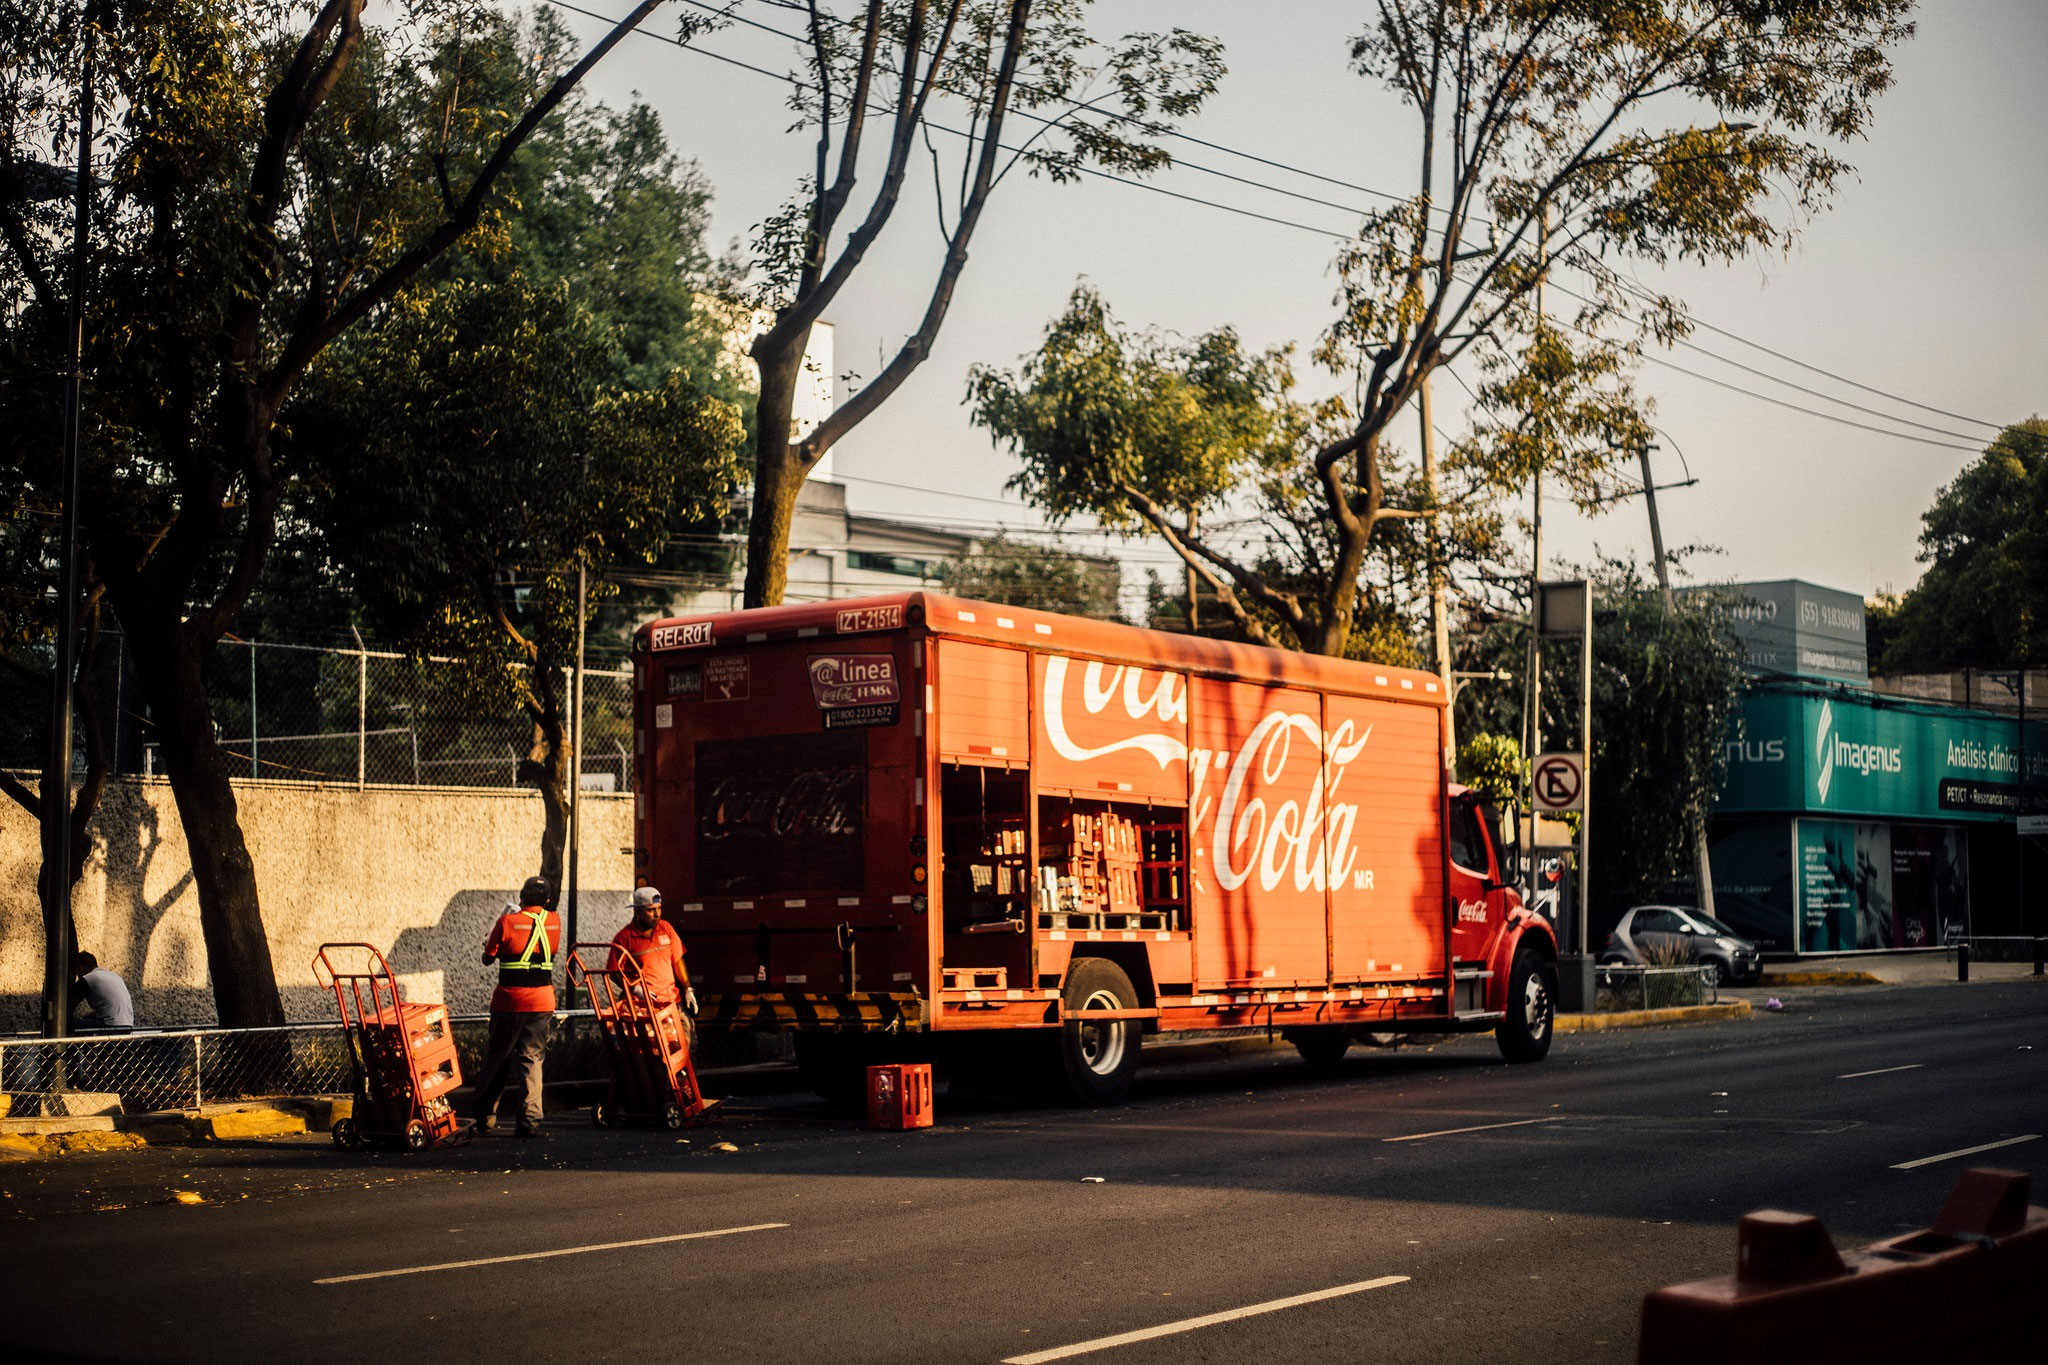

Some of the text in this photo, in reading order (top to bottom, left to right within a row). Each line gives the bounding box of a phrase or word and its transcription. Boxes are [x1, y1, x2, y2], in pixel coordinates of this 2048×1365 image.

[840, 608, 898, 630] IZT-21514
[1800, 599, 1861, 632] (55) 91830040
[653, 624, 710, 648] REI-R01
[842, 659, 891, 682] línea
[857, 685, 892, 698] FEMSA
[831, 706, 892, 720] 01800 2233 672
[1834, 731, 1901, 776] Imagenus
[1947, 738, 1987, 770] Análisis
[1946, 785, 1968, 803] PET/CT
[1354, 871, 1375, 890] MR
